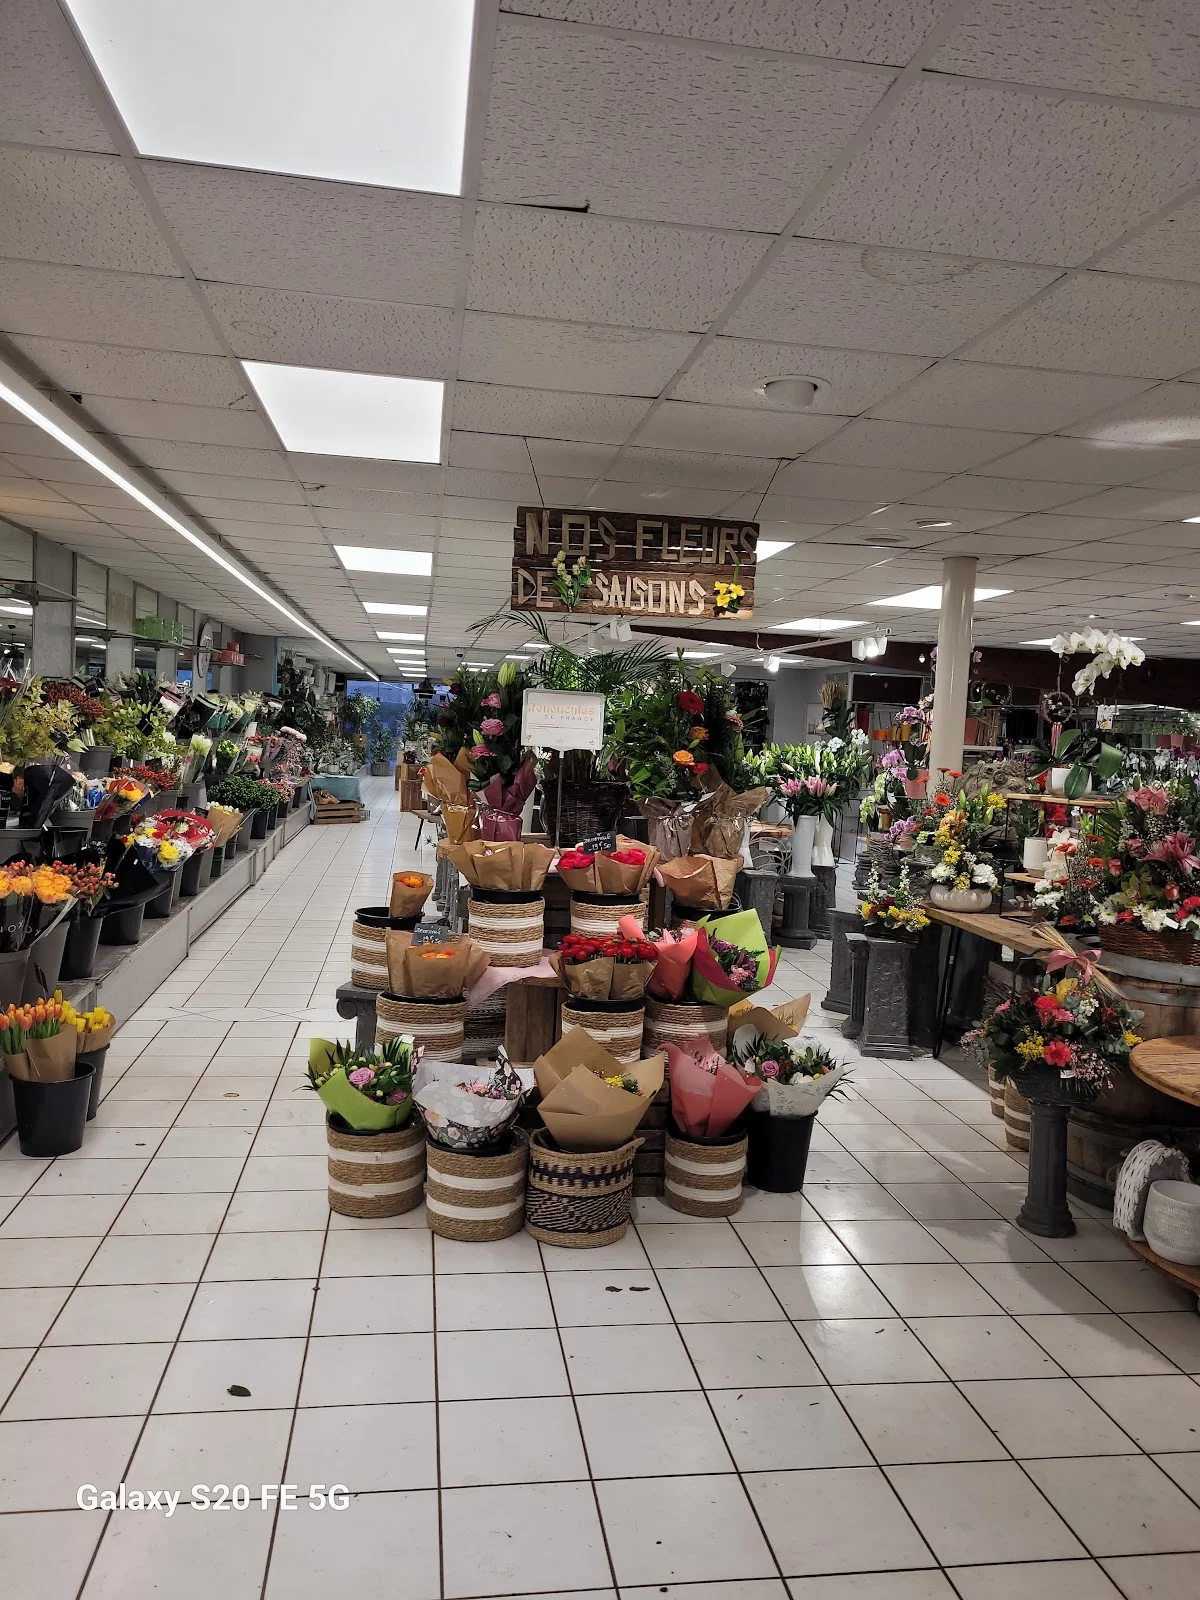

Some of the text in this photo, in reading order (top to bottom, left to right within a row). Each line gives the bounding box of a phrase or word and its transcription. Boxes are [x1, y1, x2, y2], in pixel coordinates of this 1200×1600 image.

[525, 510, 759, 565] NOS FLEURS
[517, 567, 706, 615] DE SAISONS
